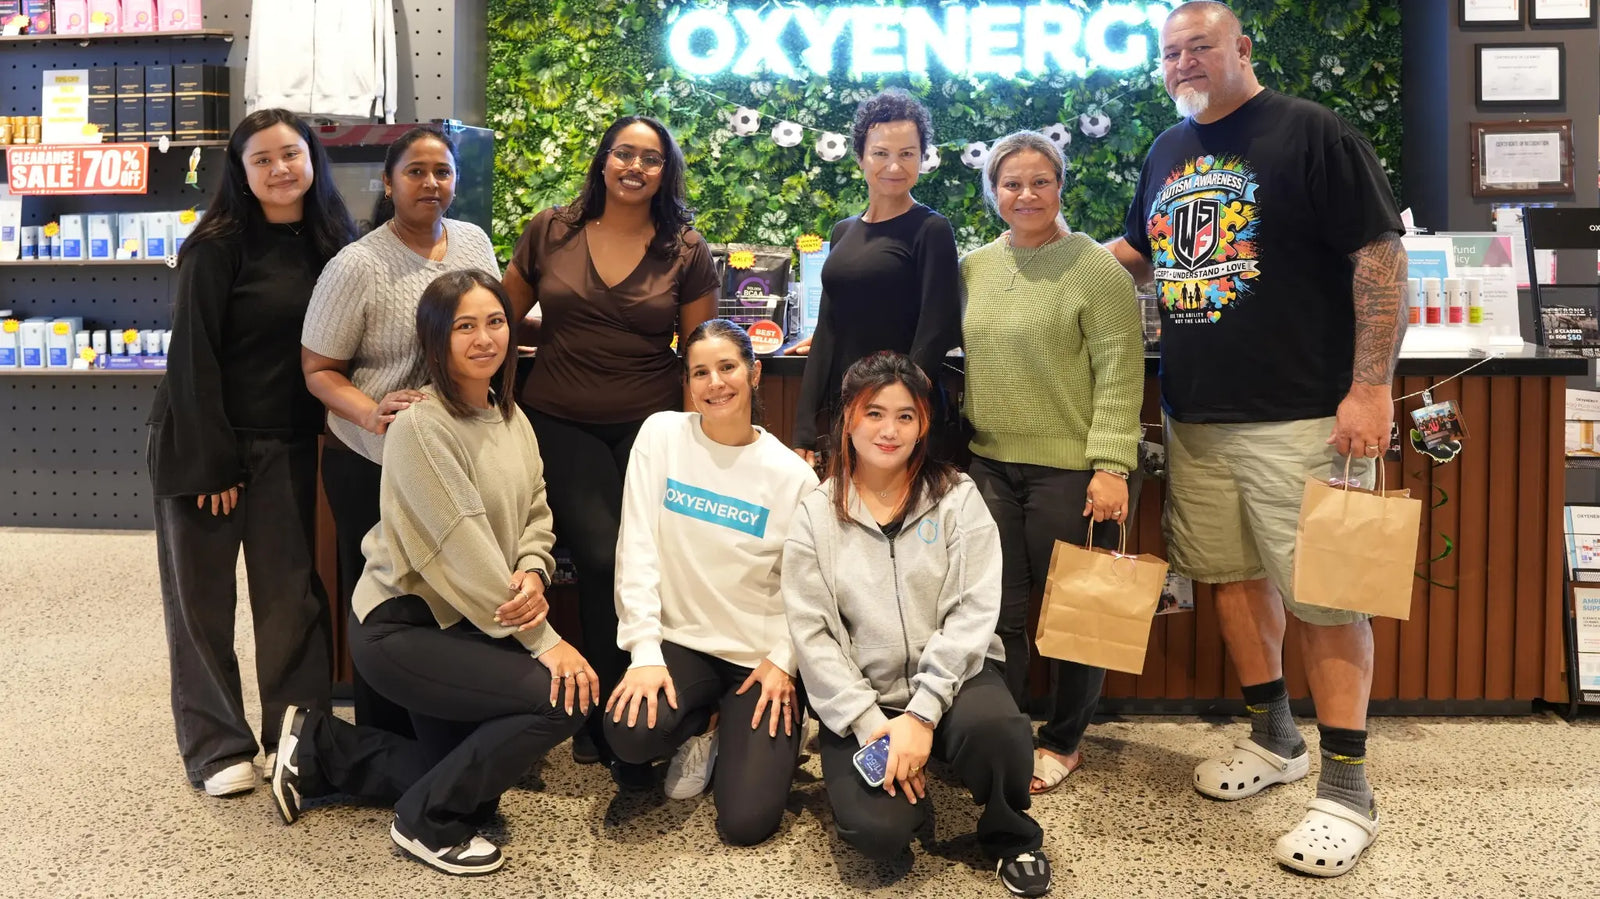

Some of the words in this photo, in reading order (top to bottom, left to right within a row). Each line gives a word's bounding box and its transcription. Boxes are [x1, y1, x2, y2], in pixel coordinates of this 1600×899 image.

[11, 151, 75, 165] CLEARANCE
[12, 165, 74, 188] SALE
[121, 170, 142, 186] OFF
[1161, 178, 1192, 202] AUTISM
[1194, 173, 1242, 190] AWARENESS
[1173, 267, 1220, 279] UNDERSTAND
[1226, 262, 1246, 272] LOVE
[666, 488, 760, 526] OXYENERGY
